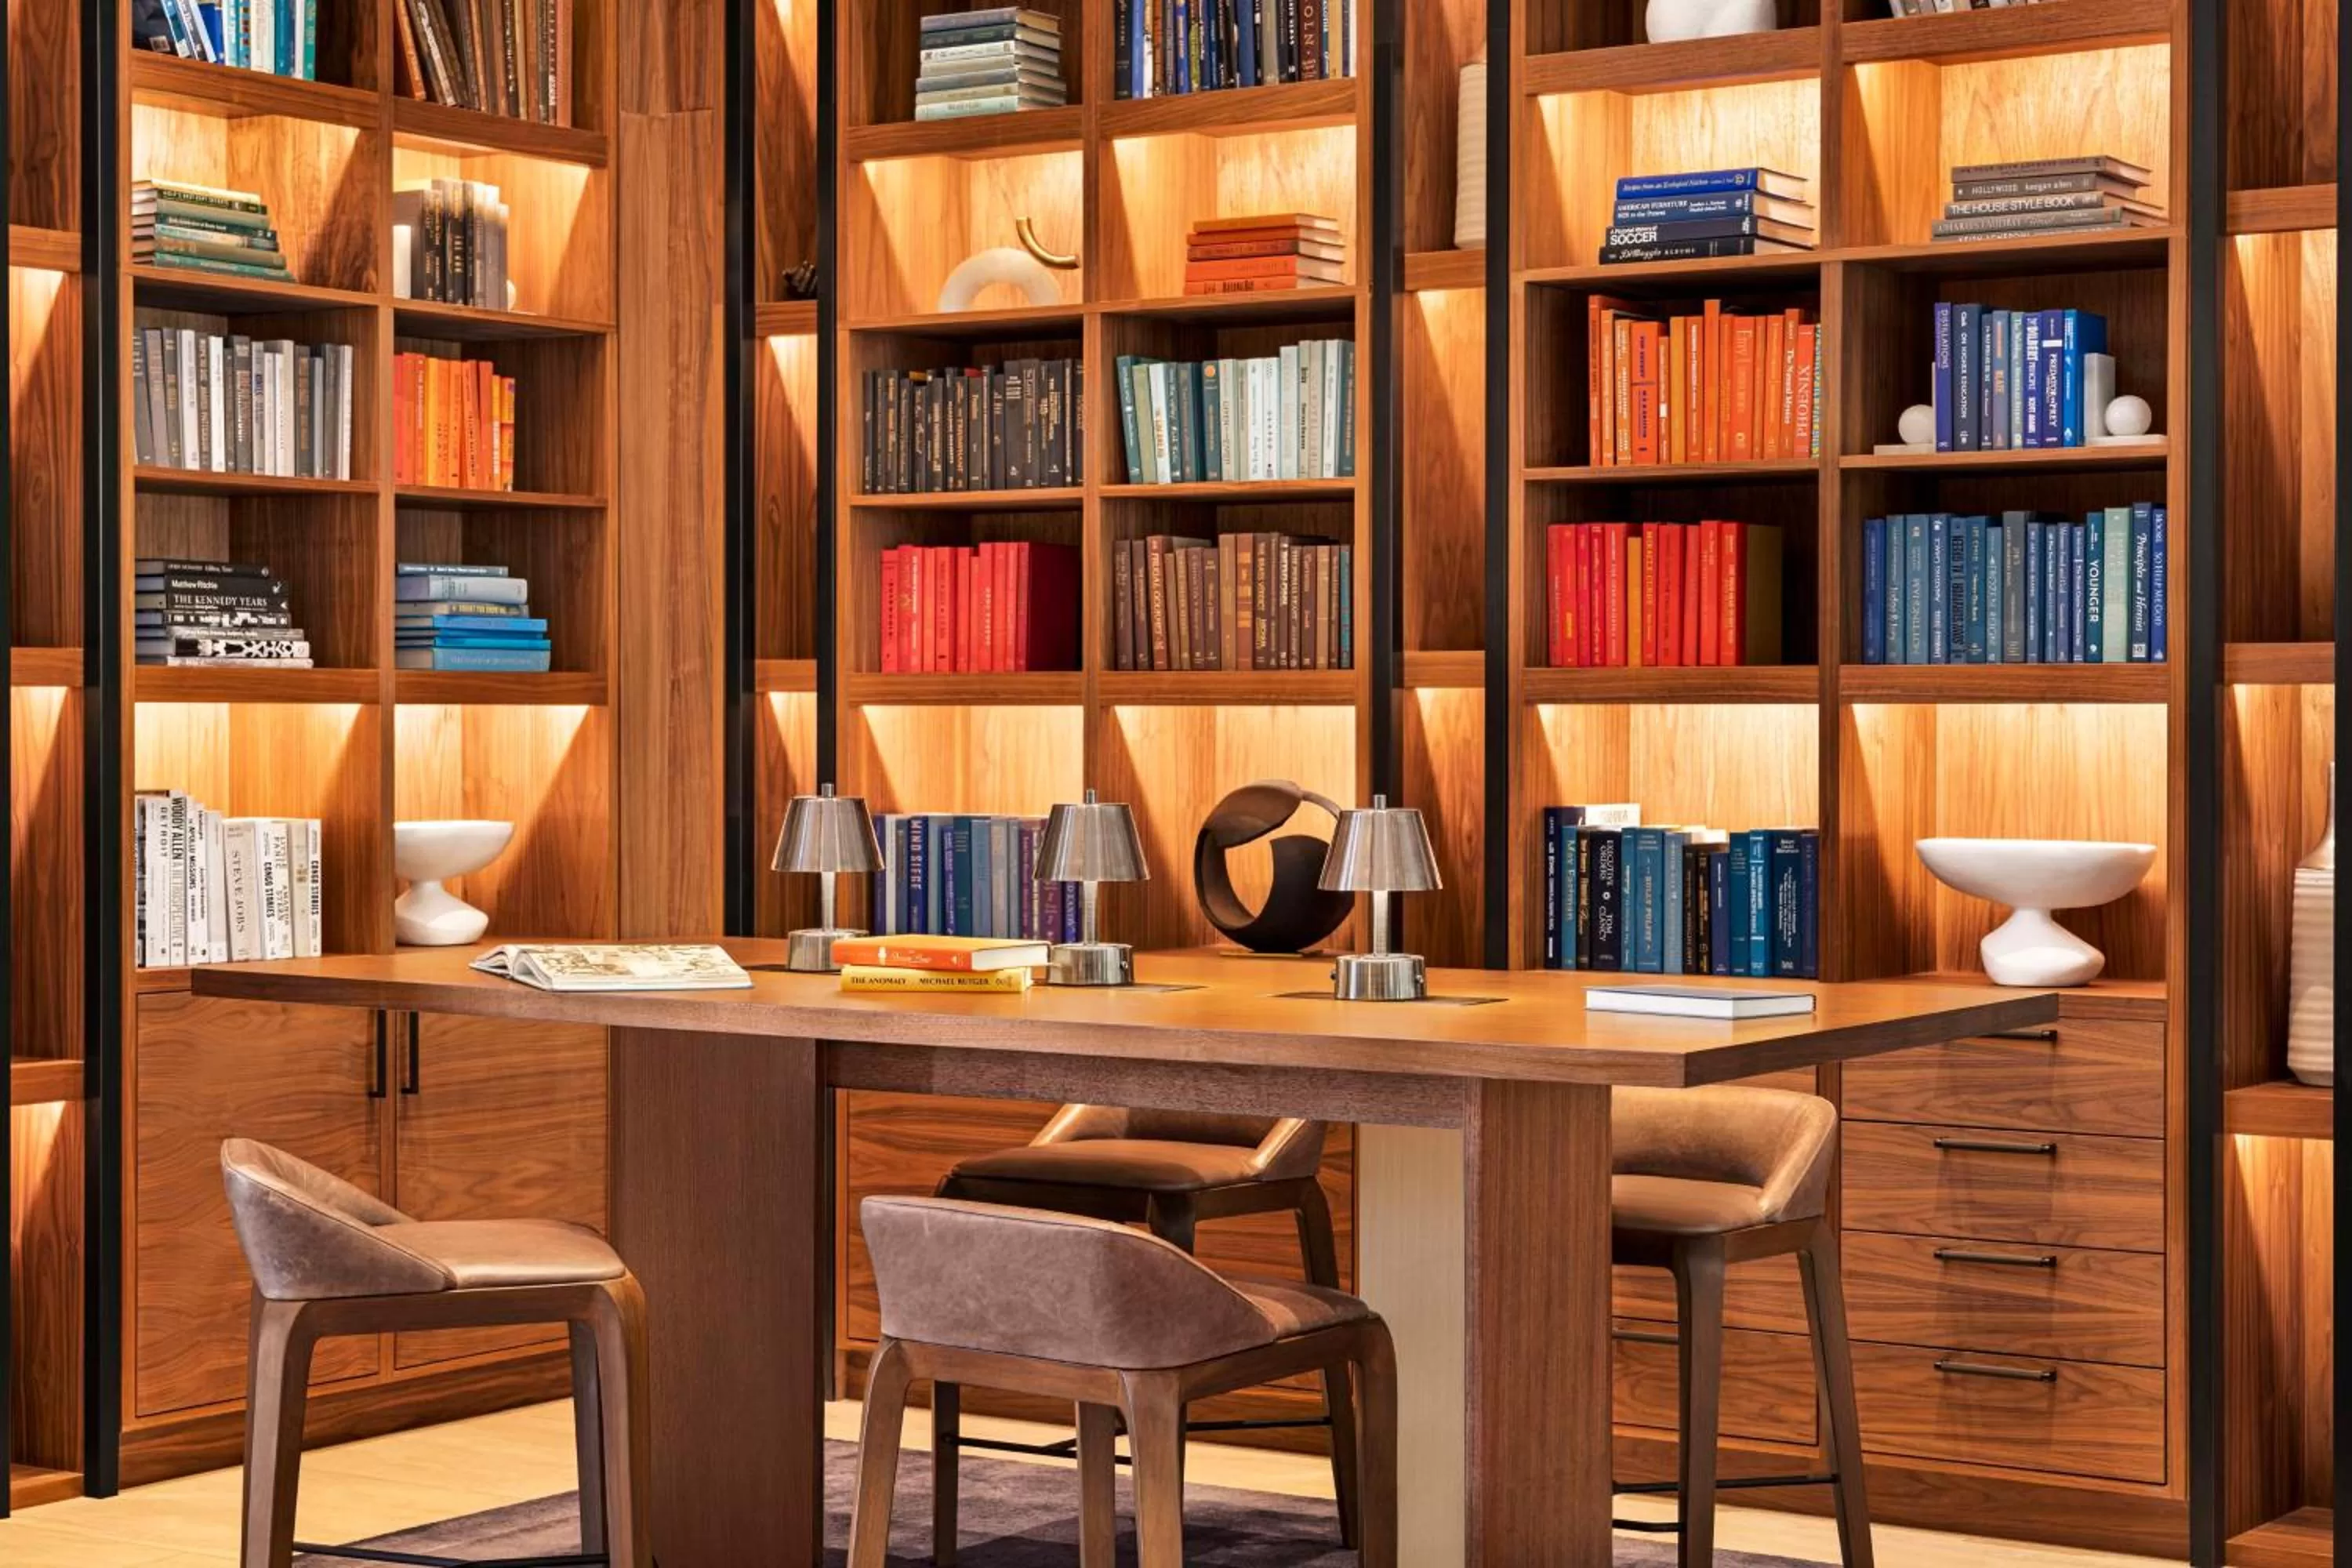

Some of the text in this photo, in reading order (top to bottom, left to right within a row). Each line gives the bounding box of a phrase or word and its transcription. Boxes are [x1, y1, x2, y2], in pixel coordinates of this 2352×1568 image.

[1304, 0, 1315, 45] OLN
[1950, 195, 2075, 215] THE HOUSE STYLE BOOK
[1610, 232, 1657, 245] SOCCER
[1940, 310, 1949, 369] DISTILLATIONS
[1961, 332, 1967, 344] ON
[2027, 325, 2038, 361] DILBERT
[1796, 365, 1810, 437] PHOENIX
[2154, 514, 2163, 543] MOORE
[172, 579, 218, 590] Matthew Ritchie
[174, 595, 267, 607] THE KENNEDY YEARS
[2089, 560, 2099, 622] YOUNGER
[2134, 532, 2147, 632] Principles and Heresies
[2153, 552, 2163, 626] SO HELP ME GOD
[159, 806, 169, 858] DETROIT
[172, 797, 184, 829] WOODY
[172, 832, 184, 859] ALLEN
[910, 819, 923, 890] MIND SIEGE
[1606, 840, 1614, 887] EXECUTIVE
[172, 868, 184, 940] RETROSPECTIVE
[232, 851, 246, 933] STEVE JOBS
[263, 862, 275, 918] CONGO STORIES
[310, 860, 319, 916] CONGO STORIES
[1599, 906, 1607, 942] CLANCY
[868, 977, 906, 985] ANOMALY
[919, 977, 955, 985] MICHAEL
[957, 977, 989, 985] RUTGER
